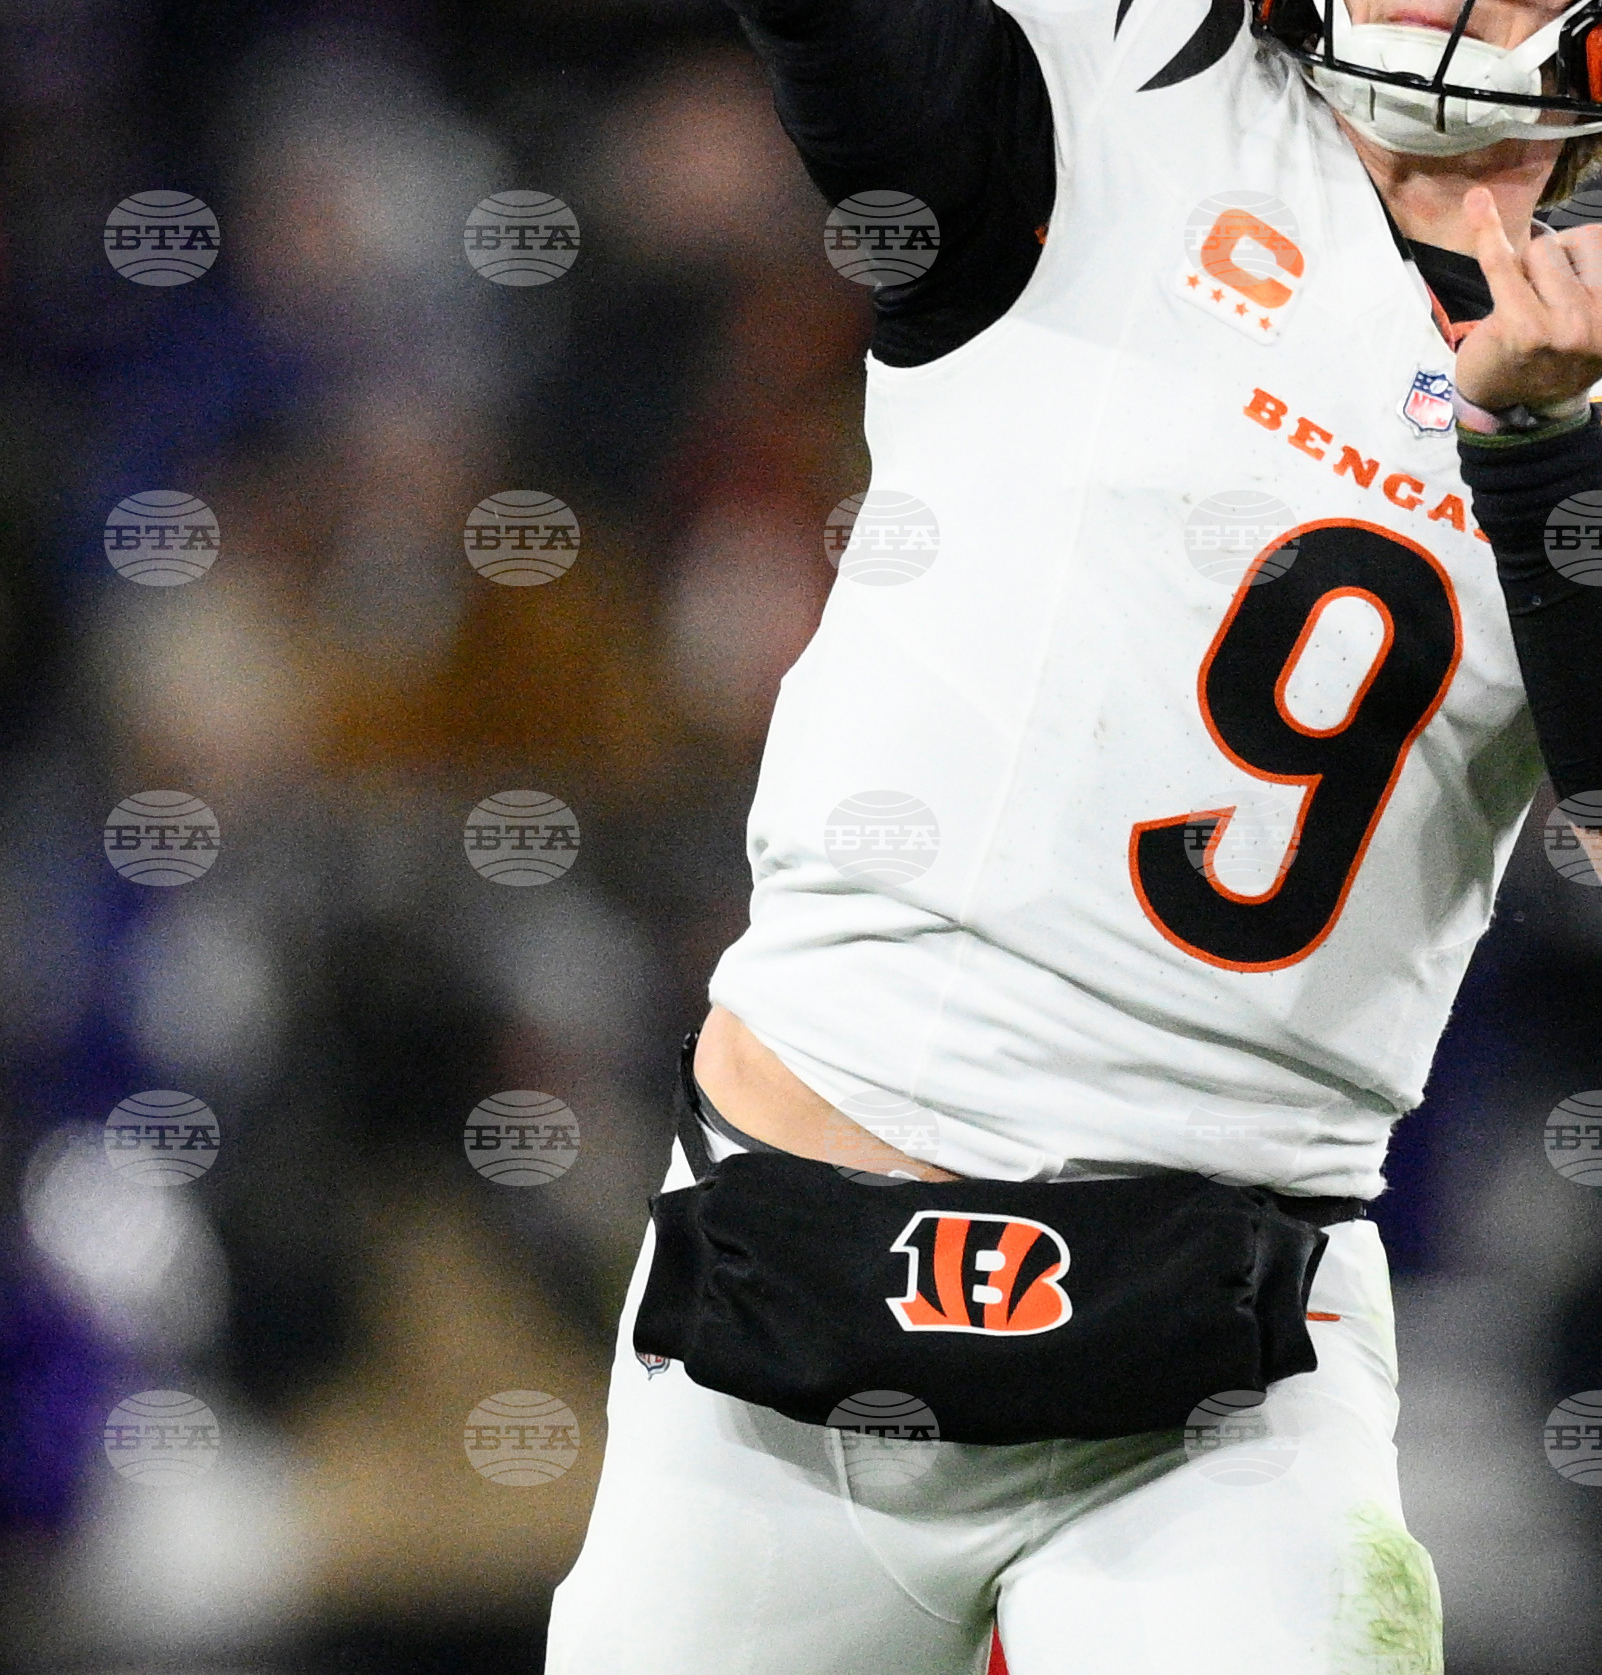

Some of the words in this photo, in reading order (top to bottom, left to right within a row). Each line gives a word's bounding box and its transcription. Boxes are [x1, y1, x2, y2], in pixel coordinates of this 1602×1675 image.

[1201, 209, 1305, 309] C
[1243, 387, 1490, 543] BENGA
[1128, 518, 1463, 973] 9
[885, 1210, 1073, 1337] B
